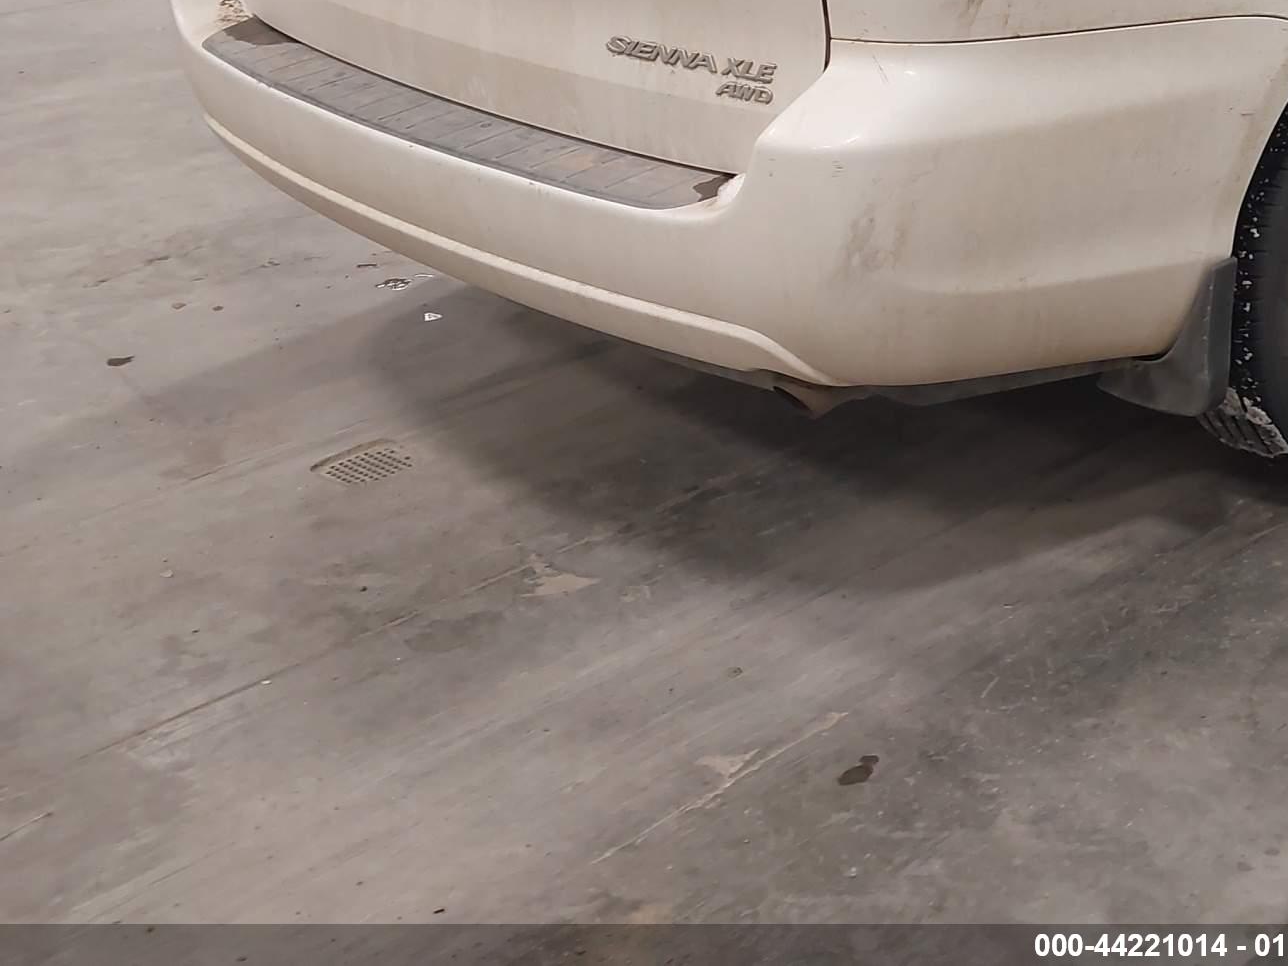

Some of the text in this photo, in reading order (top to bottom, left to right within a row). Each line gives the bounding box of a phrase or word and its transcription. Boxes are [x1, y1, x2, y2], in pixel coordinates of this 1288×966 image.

[605, 35, 778, 84] SIENNA XLE
[715, 81, 774, 105] AWD
